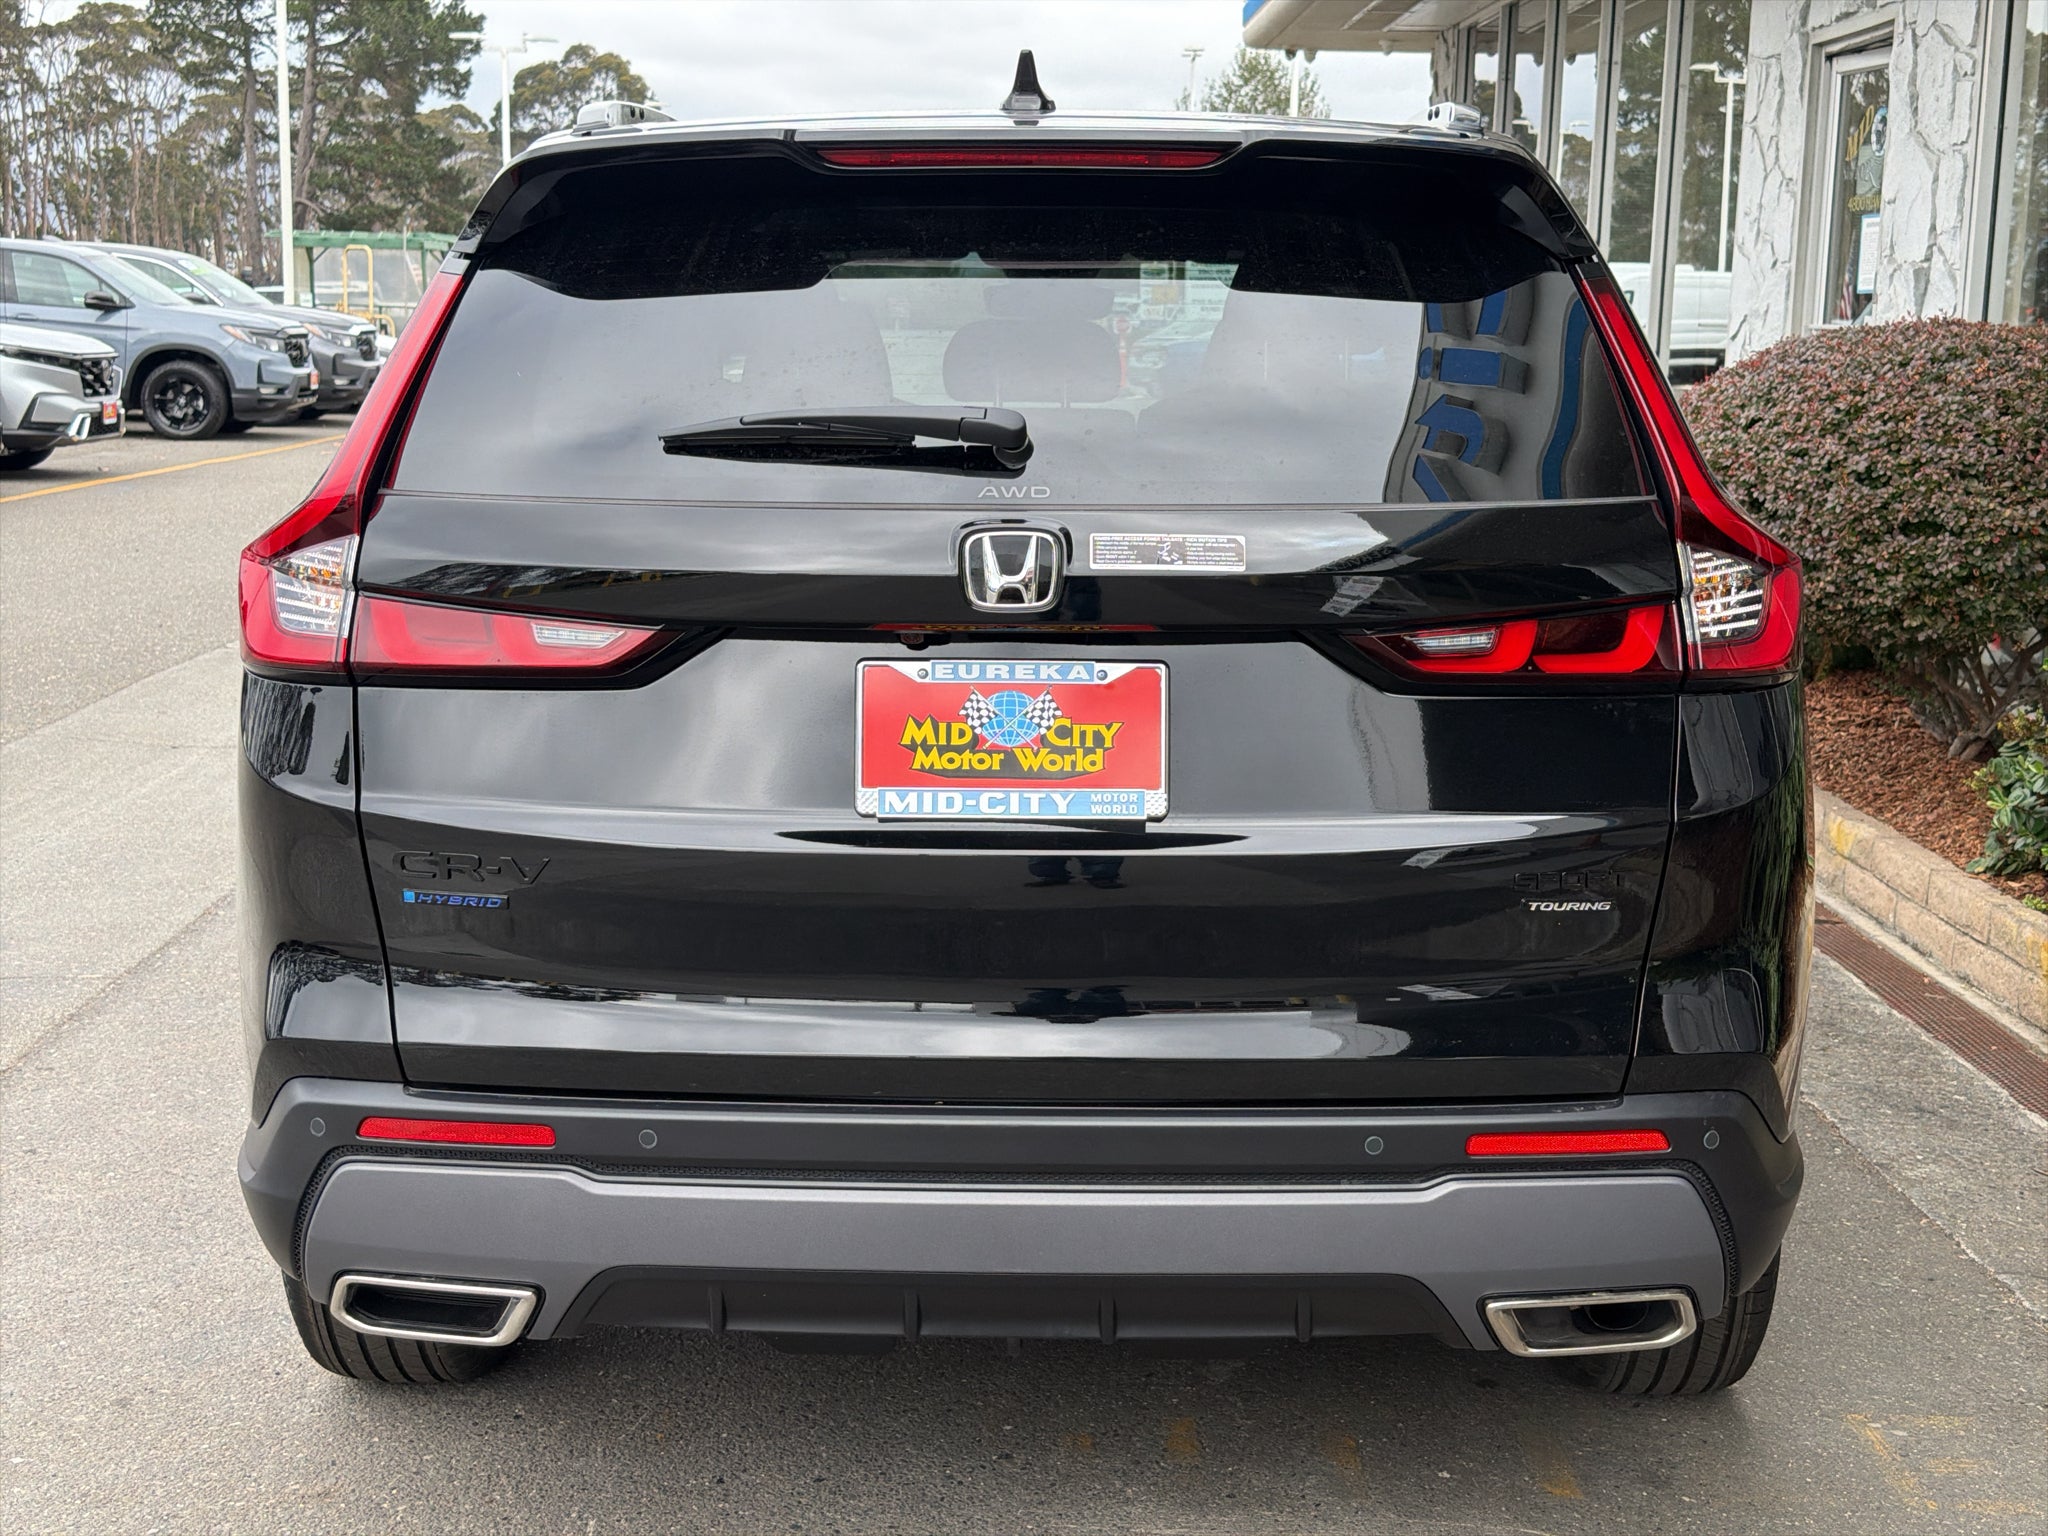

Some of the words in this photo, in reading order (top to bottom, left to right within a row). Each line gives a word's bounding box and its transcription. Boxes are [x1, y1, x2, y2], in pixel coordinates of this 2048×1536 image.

[978, 486, 1050, 498] AWD
[935, 663, 1091, 680] EUREKA
[900, 715, 973, 746] MID
[1045, 717, 1123, 748] CITY
[911, 747, 1005, 771] Motor
[1012, 747, 1105, 773] World
[884, 791, 1076, 815] MID-CITY
[1090, 793, 1138, 803] MOTOR
[1090, 804, 1138, 815] WORLD
[393, 850, 551, 885] CR-V
[417, 893, 503, 909] HYBRID
[1528, 901, 1612, 911] TOURING
